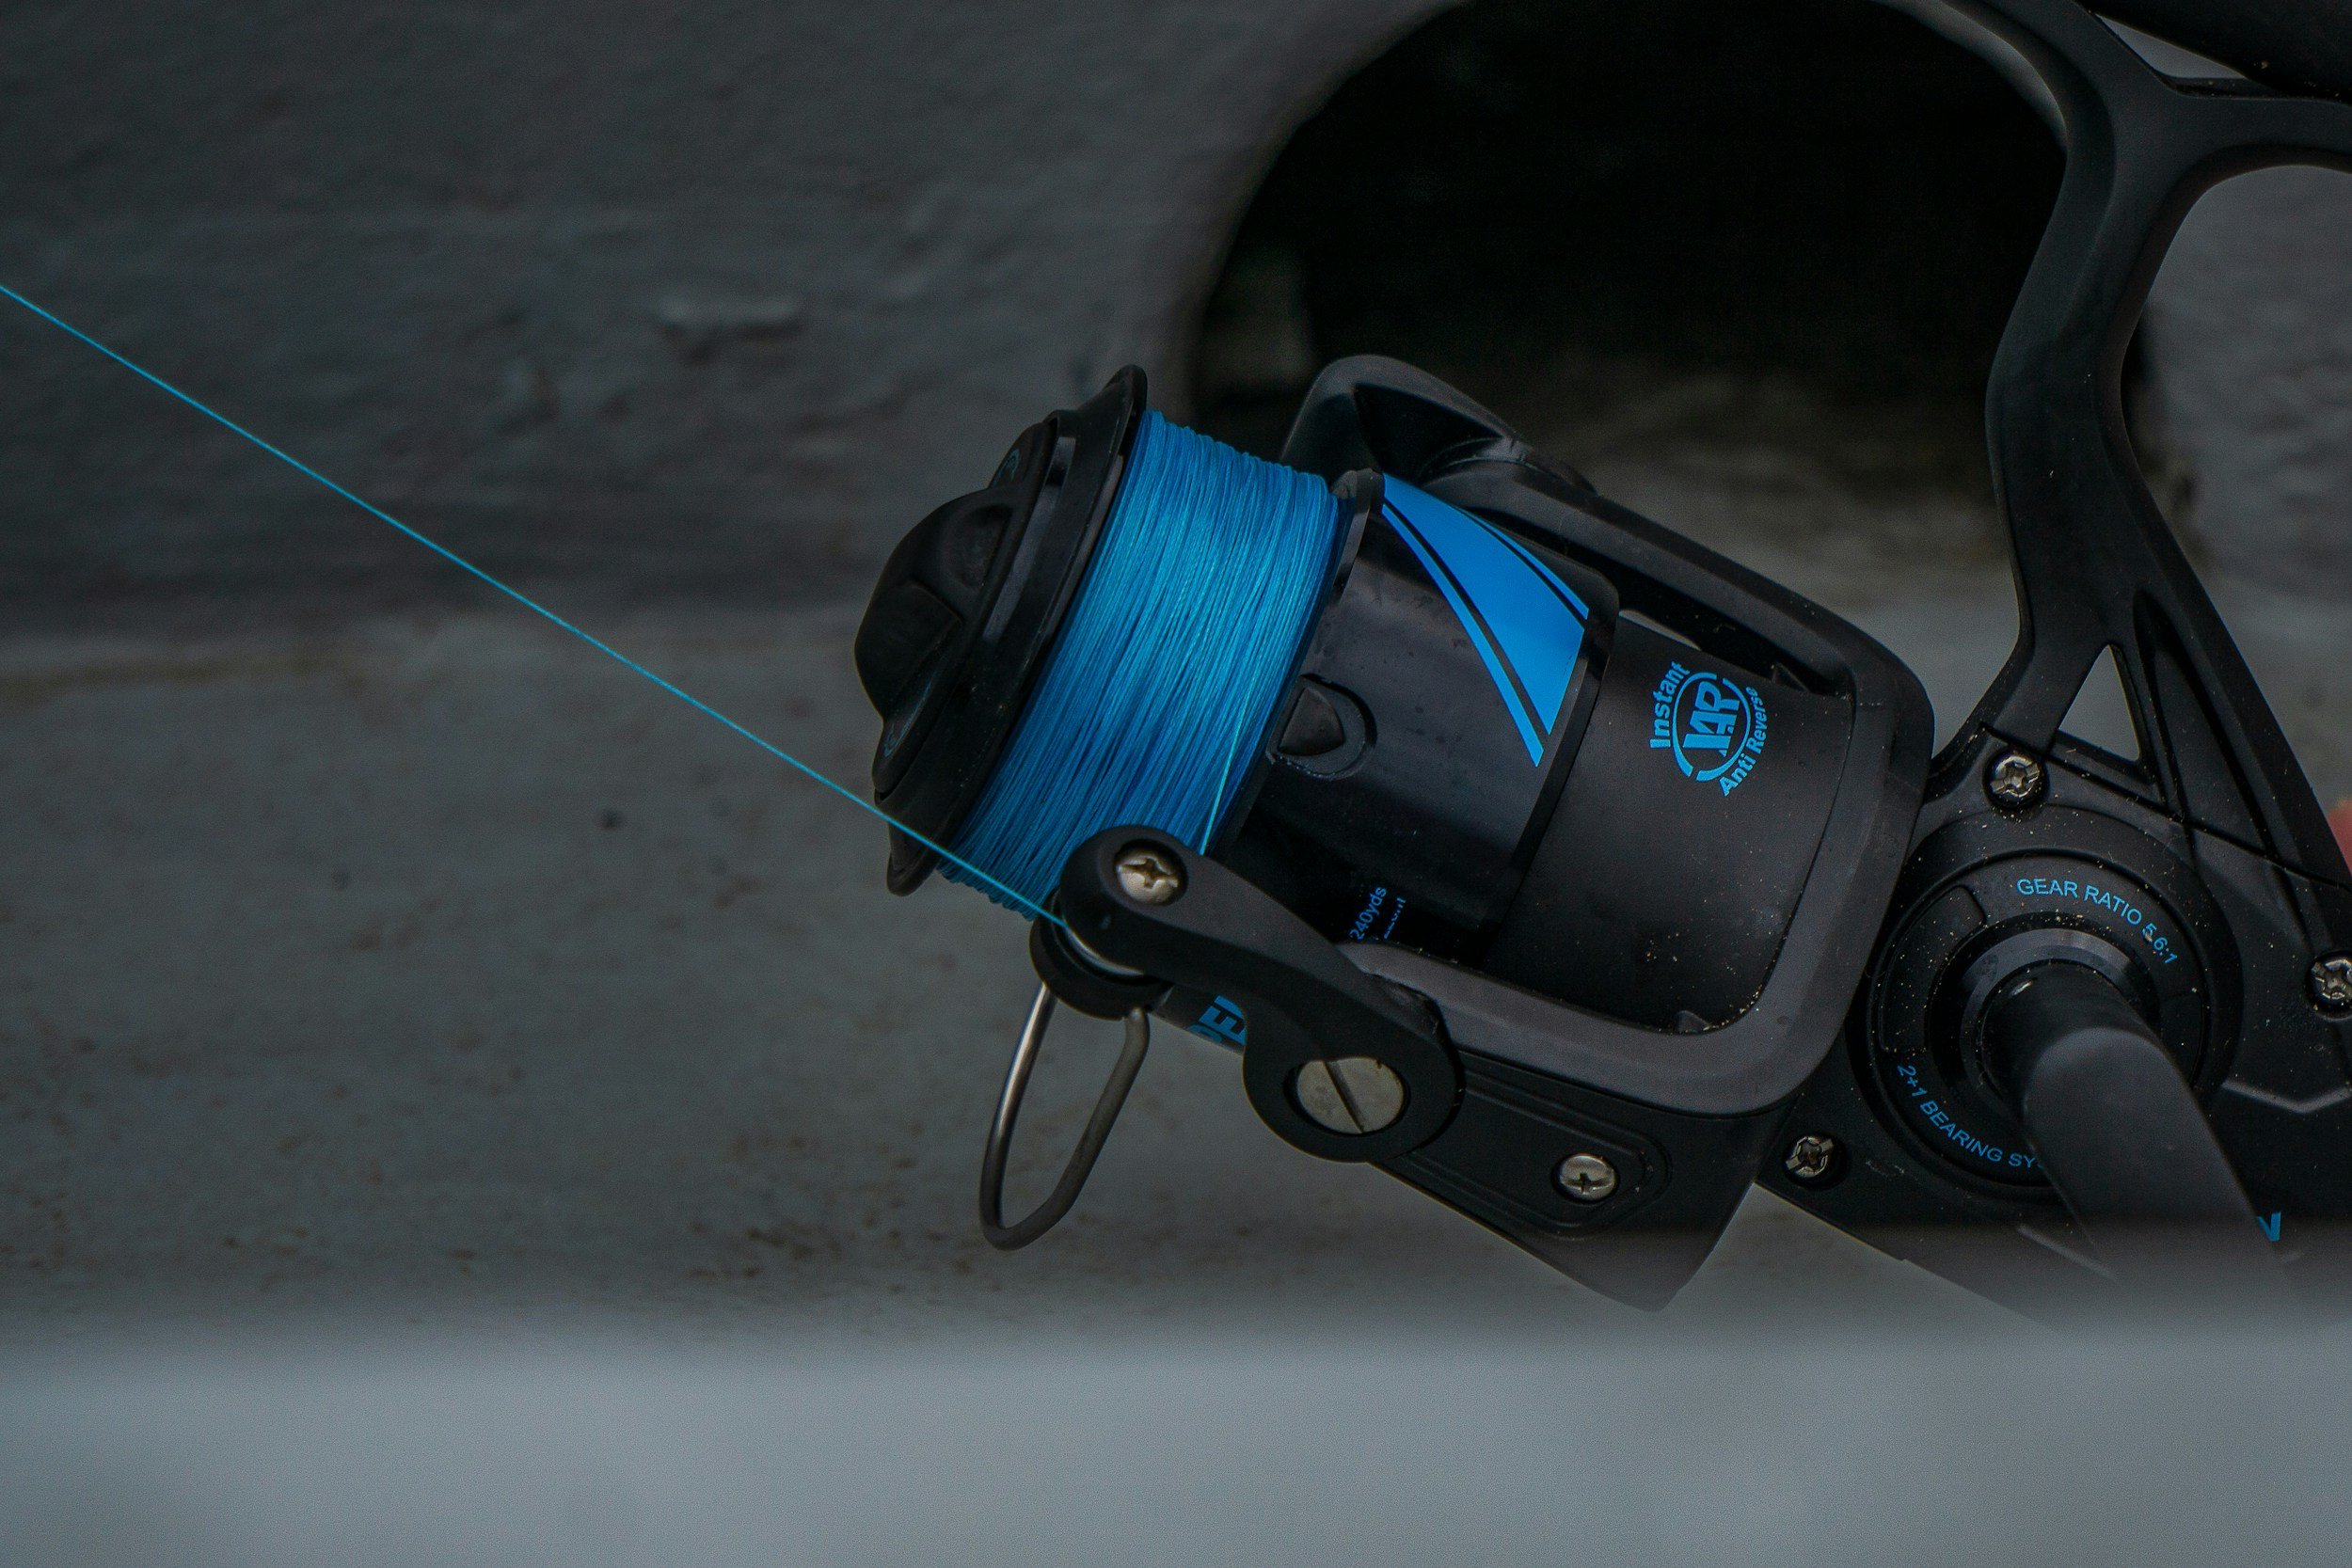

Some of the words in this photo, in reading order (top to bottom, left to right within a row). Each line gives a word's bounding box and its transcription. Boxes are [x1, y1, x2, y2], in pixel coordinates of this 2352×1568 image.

[1648, 660, 1691, 749] Instant
[1718, 753, 1756, 798] Anti
[1745, 687, 1769, 754] Reverse
[1348, 886, 1388, 942] 240yds
[2015, 877, 2079, 900] GEAR
[2083, 883, 2144, 927] RATIO
[2140, 922, 2179, 964] 56:1
[1897, 1064, 1928, 1098] 2+1
[1918, 1099, 2004, 1164] BEARING
